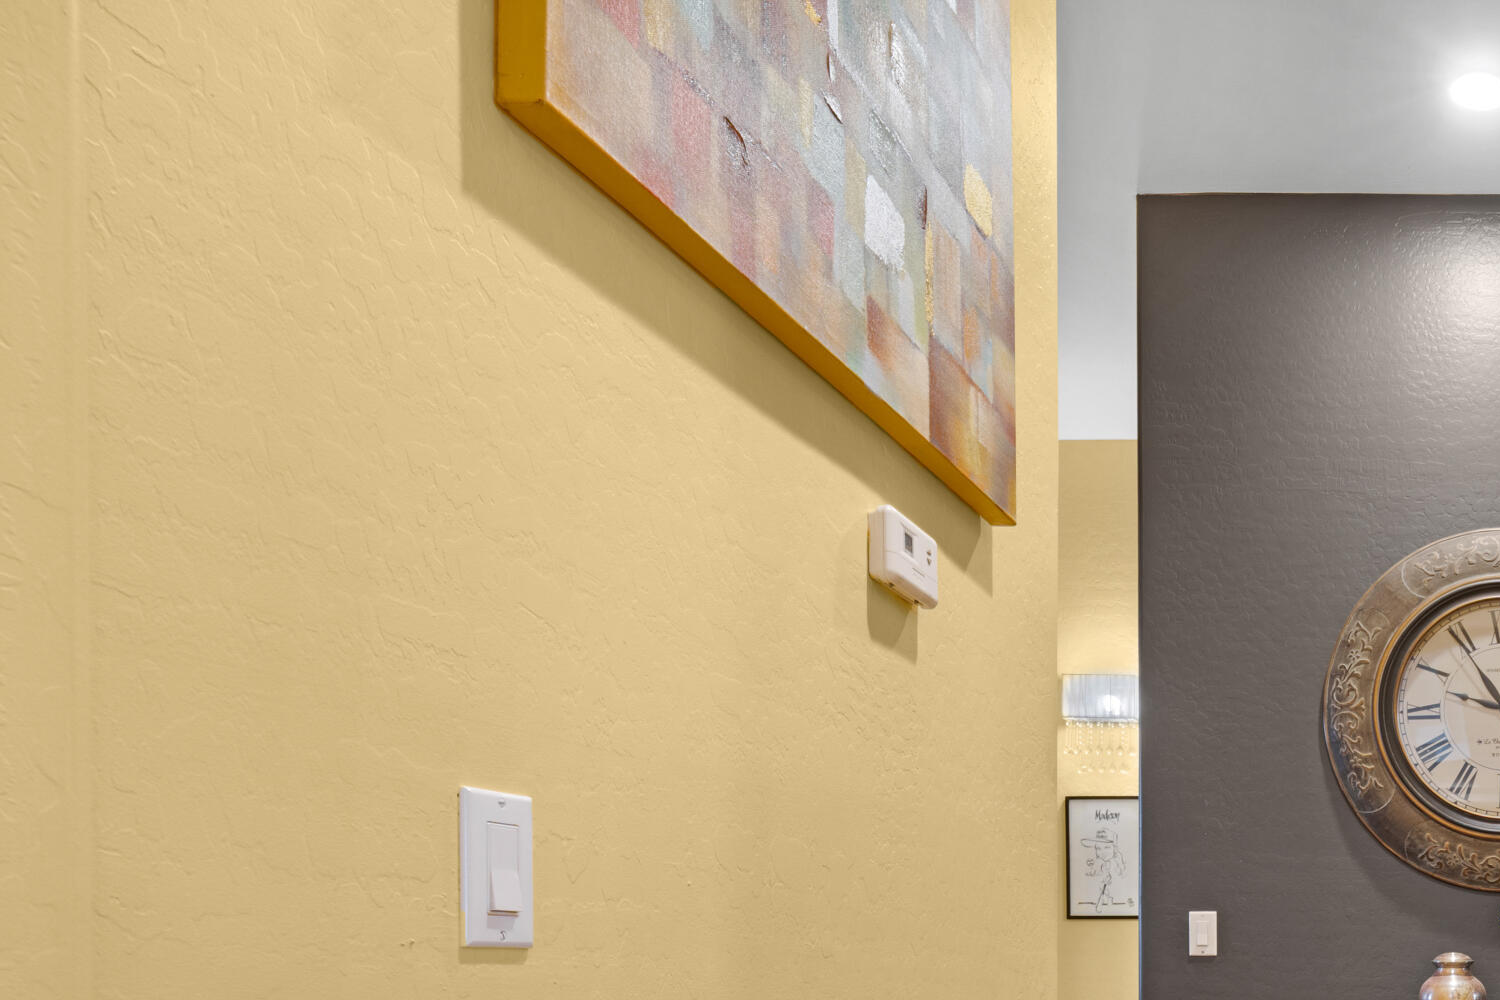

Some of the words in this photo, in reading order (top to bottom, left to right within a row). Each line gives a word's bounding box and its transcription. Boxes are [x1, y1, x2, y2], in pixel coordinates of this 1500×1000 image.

[1406, 701, 1441, 722] IX
[1413, 729, 1453, 773] VIII
[1448, 759, 1479, 803] VII
